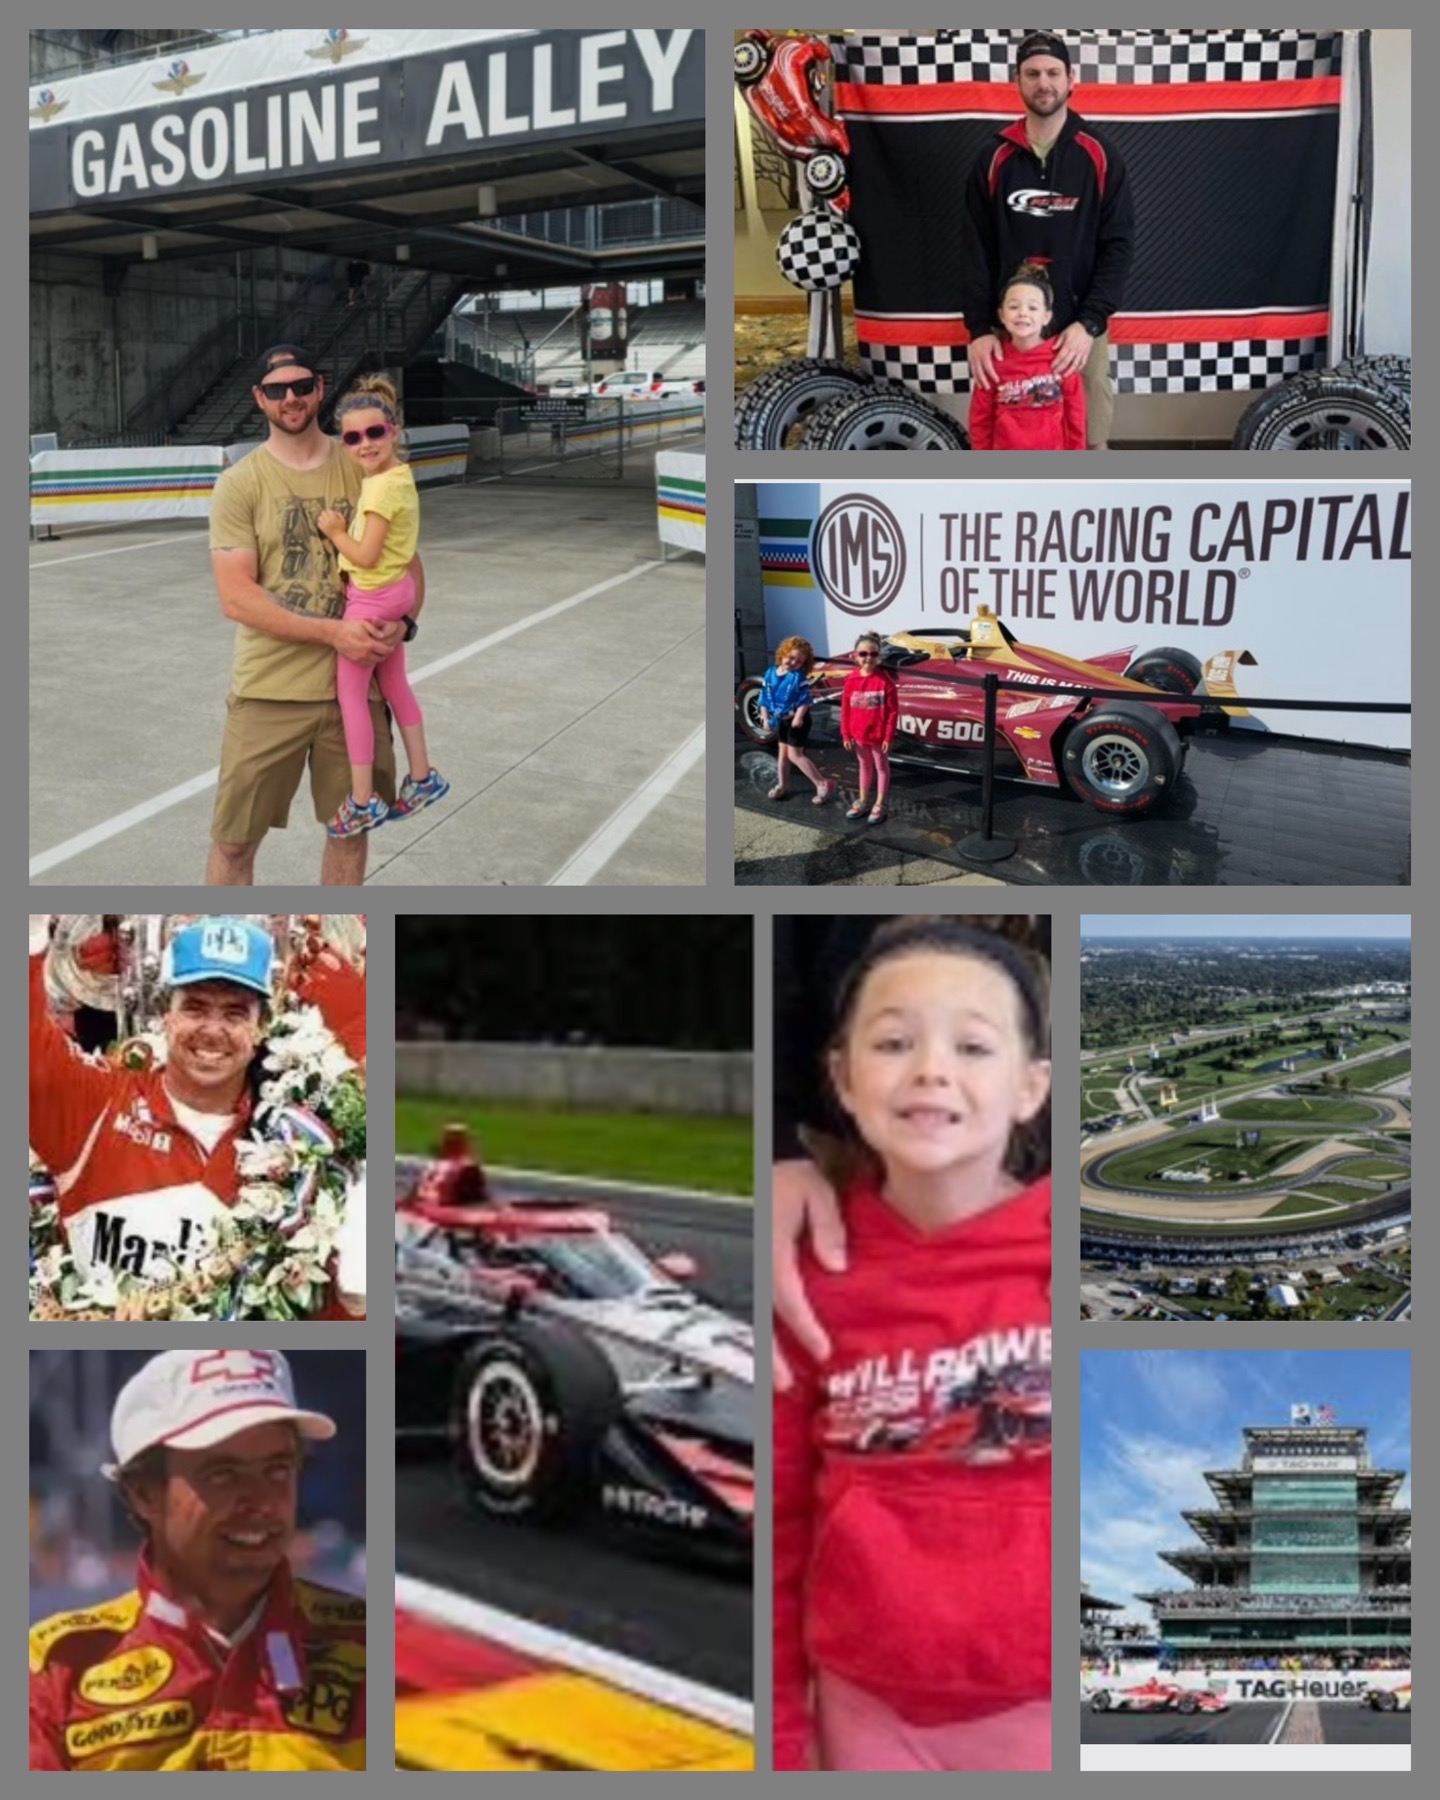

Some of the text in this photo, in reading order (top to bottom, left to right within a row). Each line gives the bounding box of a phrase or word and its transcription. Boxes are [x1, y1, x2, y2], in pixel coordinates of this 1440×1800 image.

[72, 29, 694, 197] GASOLINE ALLEY
[939, 491, 1411, 563] THE RACING CAPITAL
[828, 511, 893, 599] IMS
[940, 567, 1237, 627] OF THE WORLD
[1006, 669, 1040, 685] THIS
[1040, 677, 1057, 686] IS
[937, 720, 985, 742] 500
[828, 1348, 921, 1397] WILL
[1236, 1679, 1287, 1698] TAG
